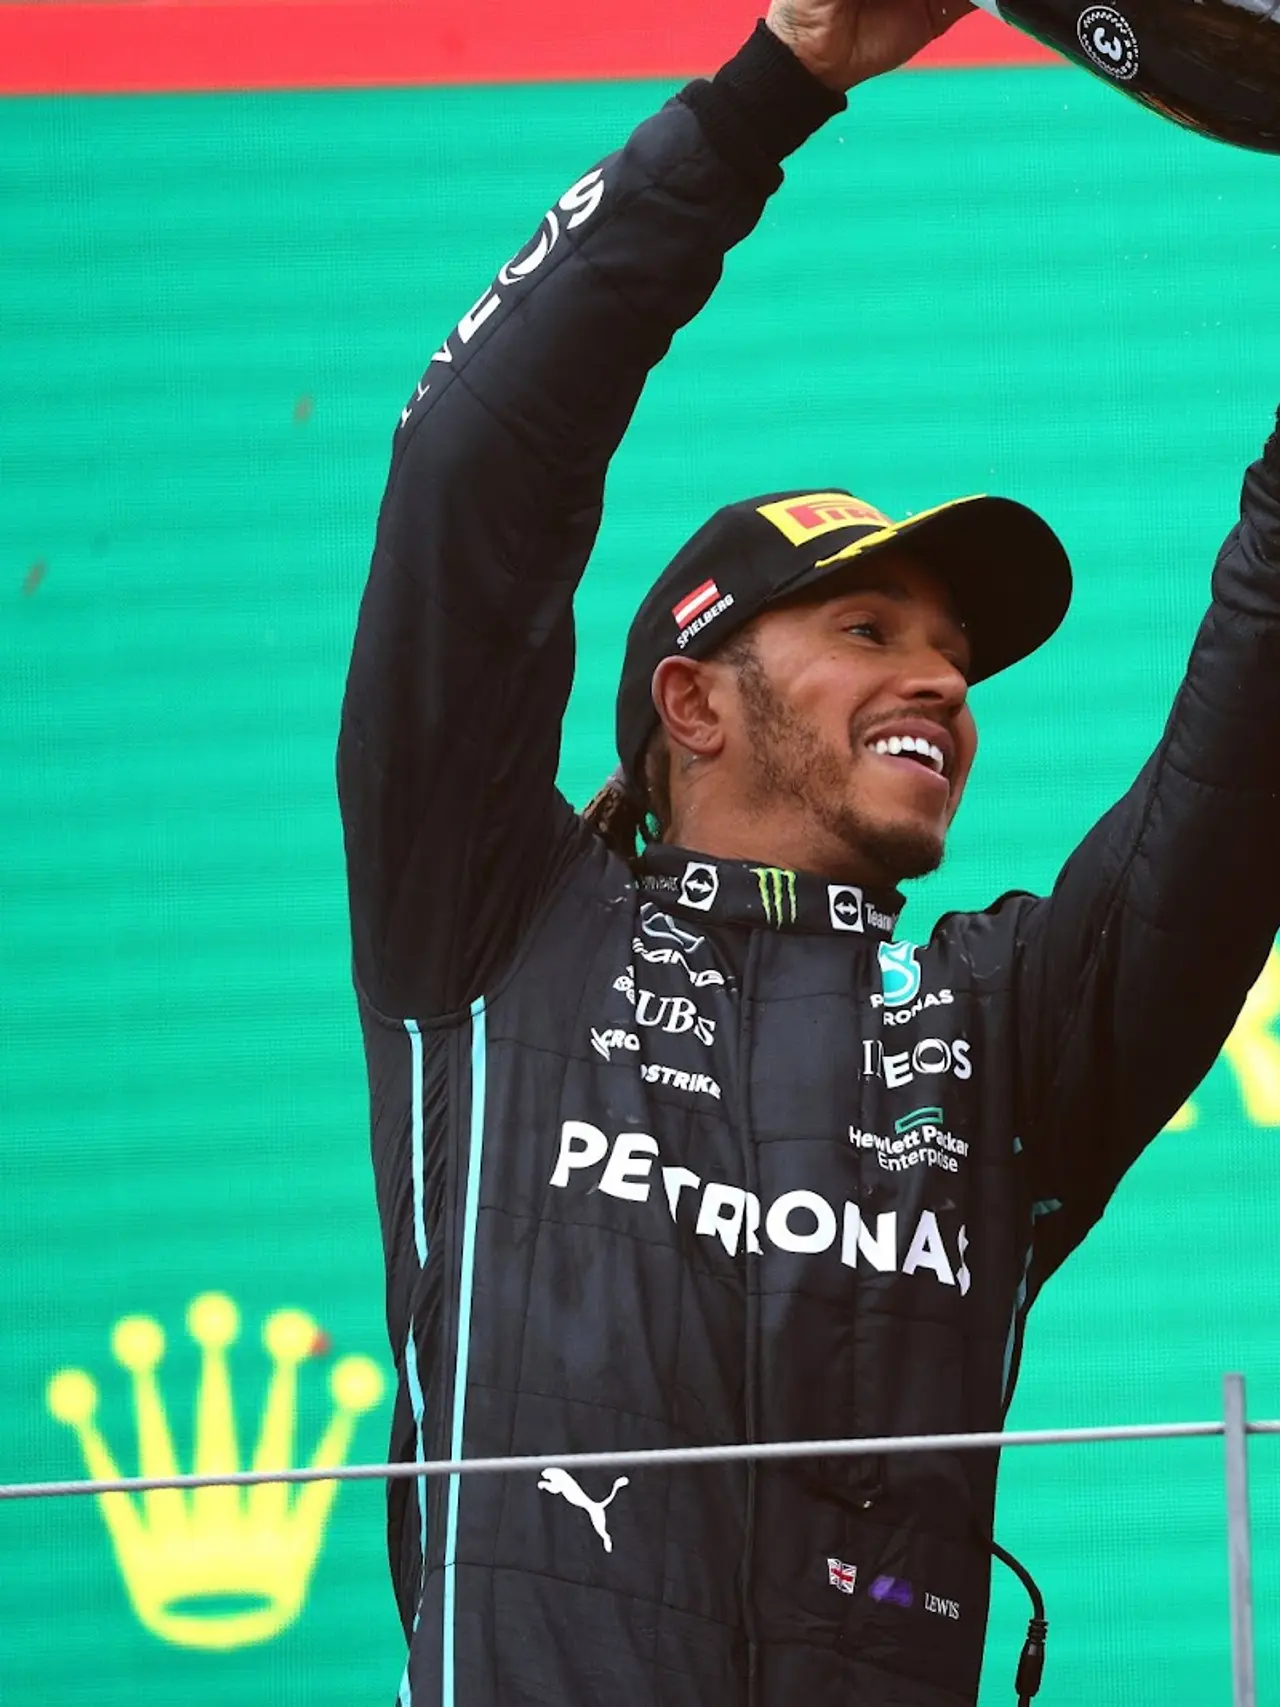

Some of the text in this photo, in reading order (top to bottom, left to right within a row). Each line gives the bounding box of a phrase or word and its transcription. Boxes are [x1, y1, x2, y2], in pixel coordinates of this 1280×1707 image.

[677, 594, 734, 649] SPIELBERG
[635, 989, 716, 1046] UBS
[924, 1592, 960, 1620] LEWIS
